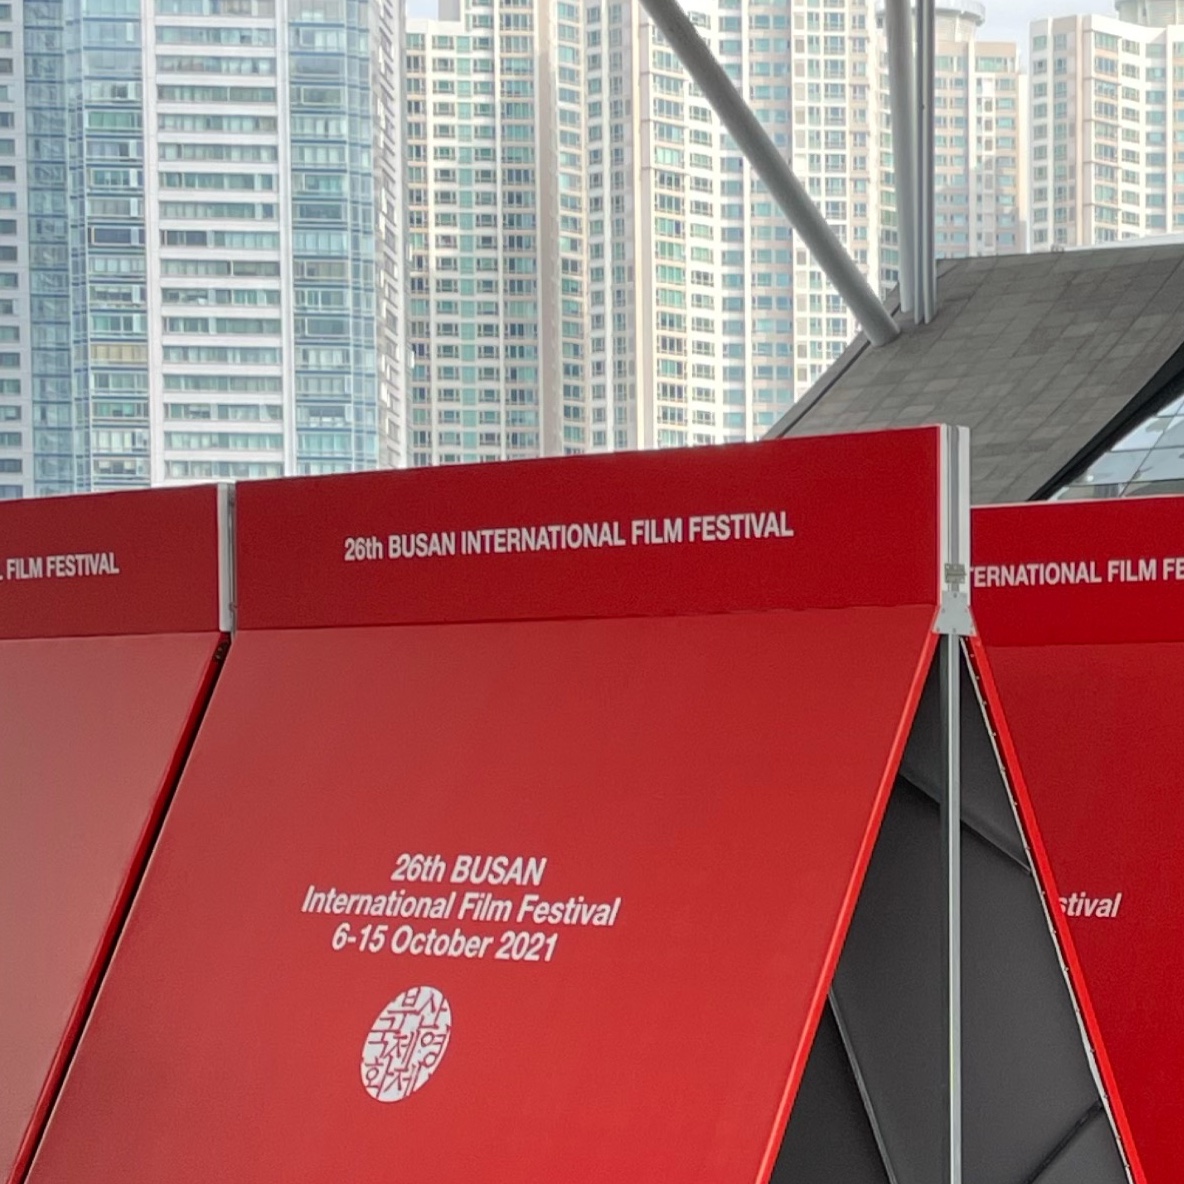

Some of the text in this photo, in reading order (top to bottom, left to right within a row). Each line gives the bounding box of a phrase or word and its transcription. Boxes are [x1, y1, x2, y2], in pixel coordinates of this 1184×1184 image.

[345, 511, 794, 561] 26th BUSAN INTERNATIONAL FILM FESTIVAL
[7, 557, 42, 580] FILM
[46, 552, 119, 577] FESTIVAL
[971, 561, 1102, 588] ERNATIONAL
[1108, 558, 1156, 582] FILM
[391, 853, 547, 885] 26th BUSAN
[301, 885, 621, 926] International Film Festival
[1058, 891, 1122, 918] stival
[331, 922, 558, 961] 6-15 October 2021
